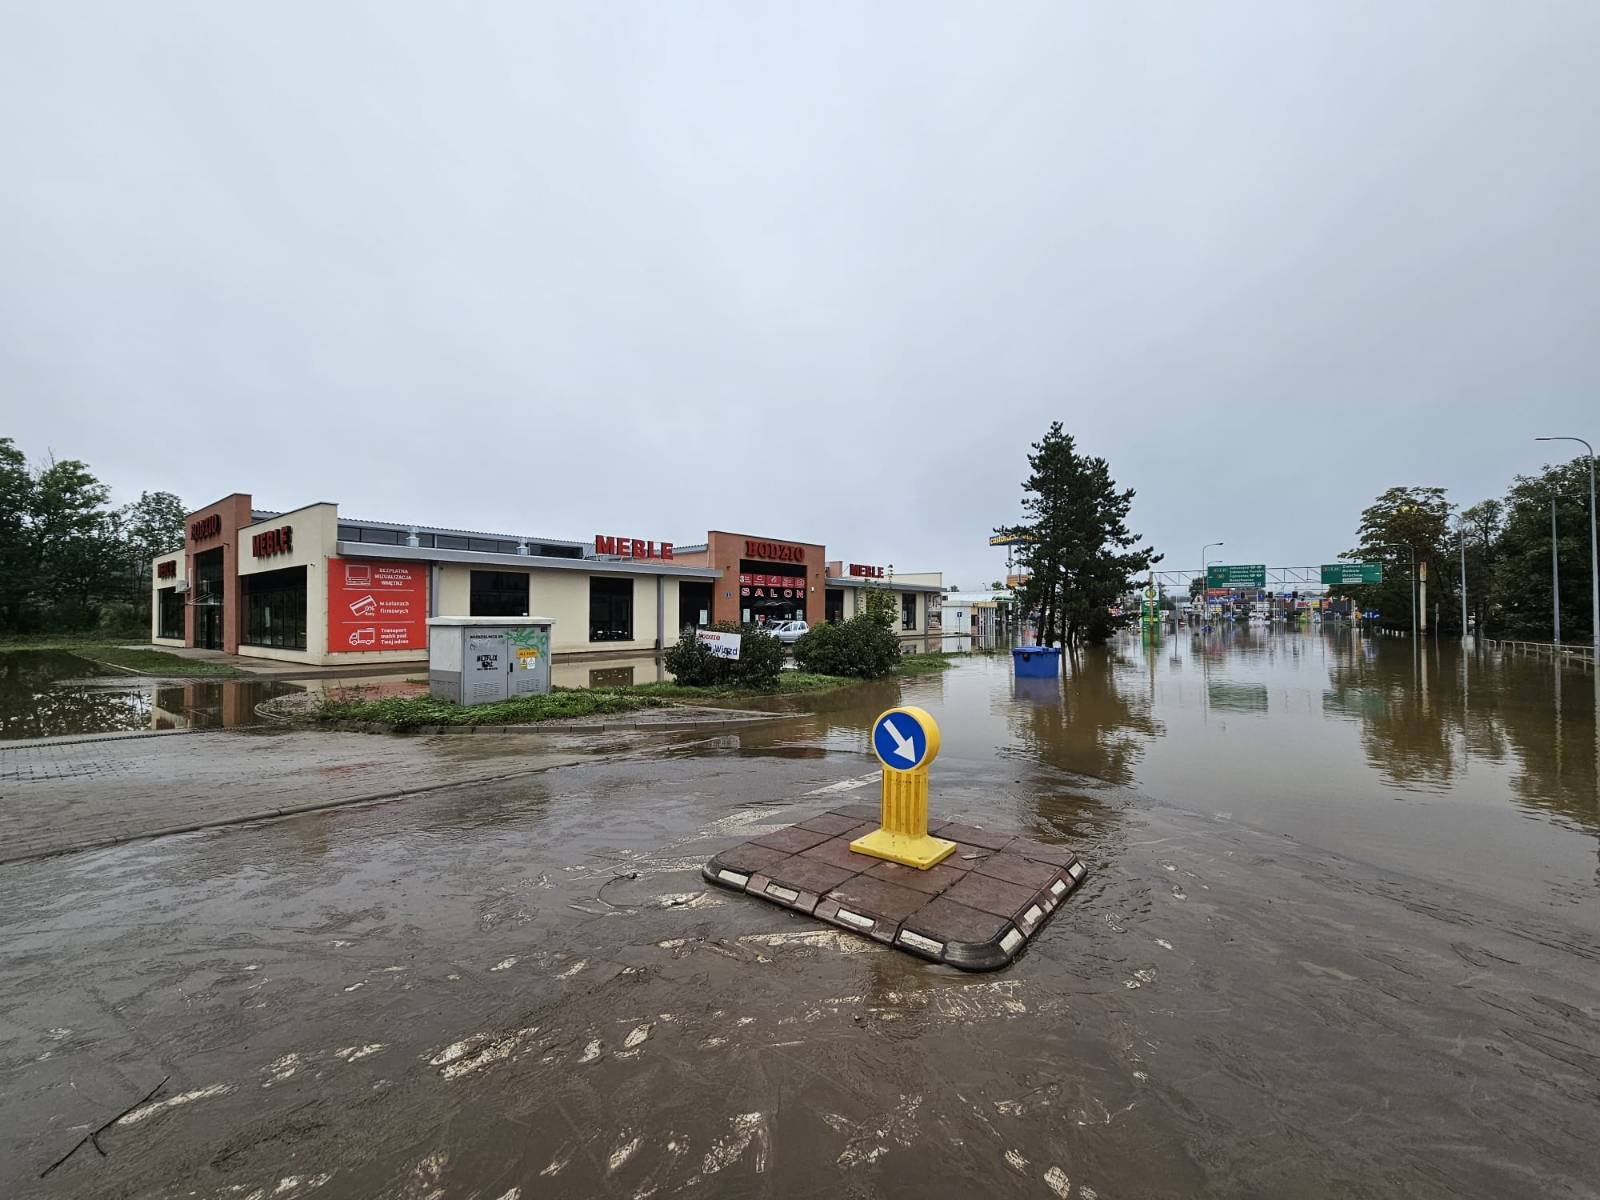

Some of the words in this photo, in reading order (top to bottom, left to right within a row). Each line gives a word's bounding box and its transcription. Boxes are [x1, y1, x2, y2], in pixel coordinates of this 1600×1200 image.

[252, 525, 293, 558] MEBLE
[595, 535, 673, 560] MEBLE
[745, 541, 805, 562] BODZIO
[849, 563, 884, 578] MEBLE
[741, 587, 804, 599] SALON
